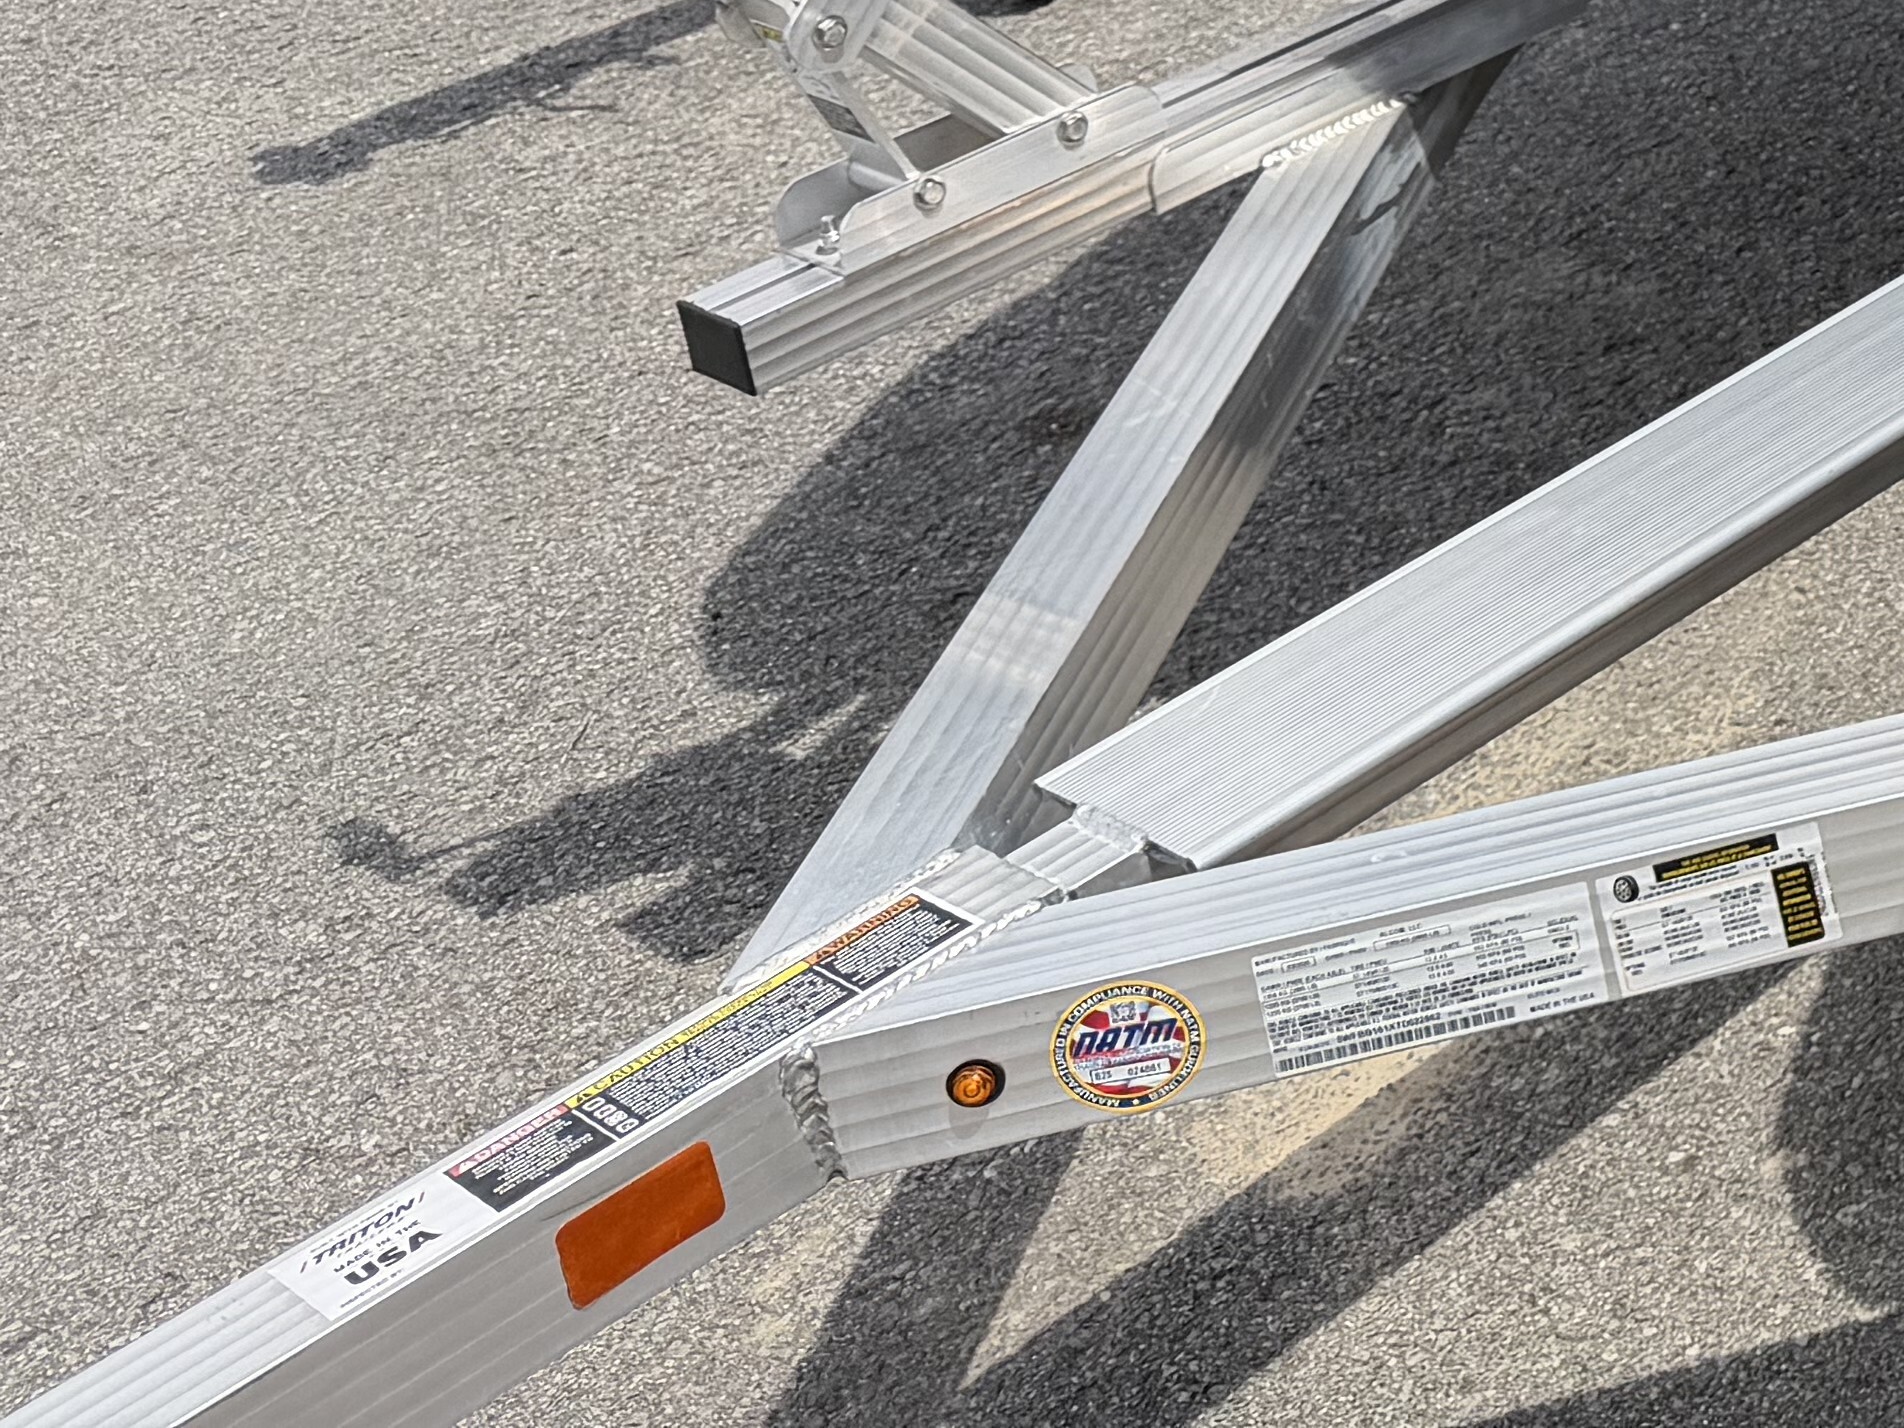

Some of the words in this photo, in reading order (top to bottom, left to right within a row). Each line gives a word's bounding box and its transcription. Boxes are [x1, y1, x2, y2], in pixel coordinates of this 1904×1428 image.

[1068, 985, 1149, 1021] COMPLIANCE
[1152, 989, 1183, 1010] WITH
[310, 1197, 418, 1265] TRITON
[343, 1221, 444, 1289] USA
